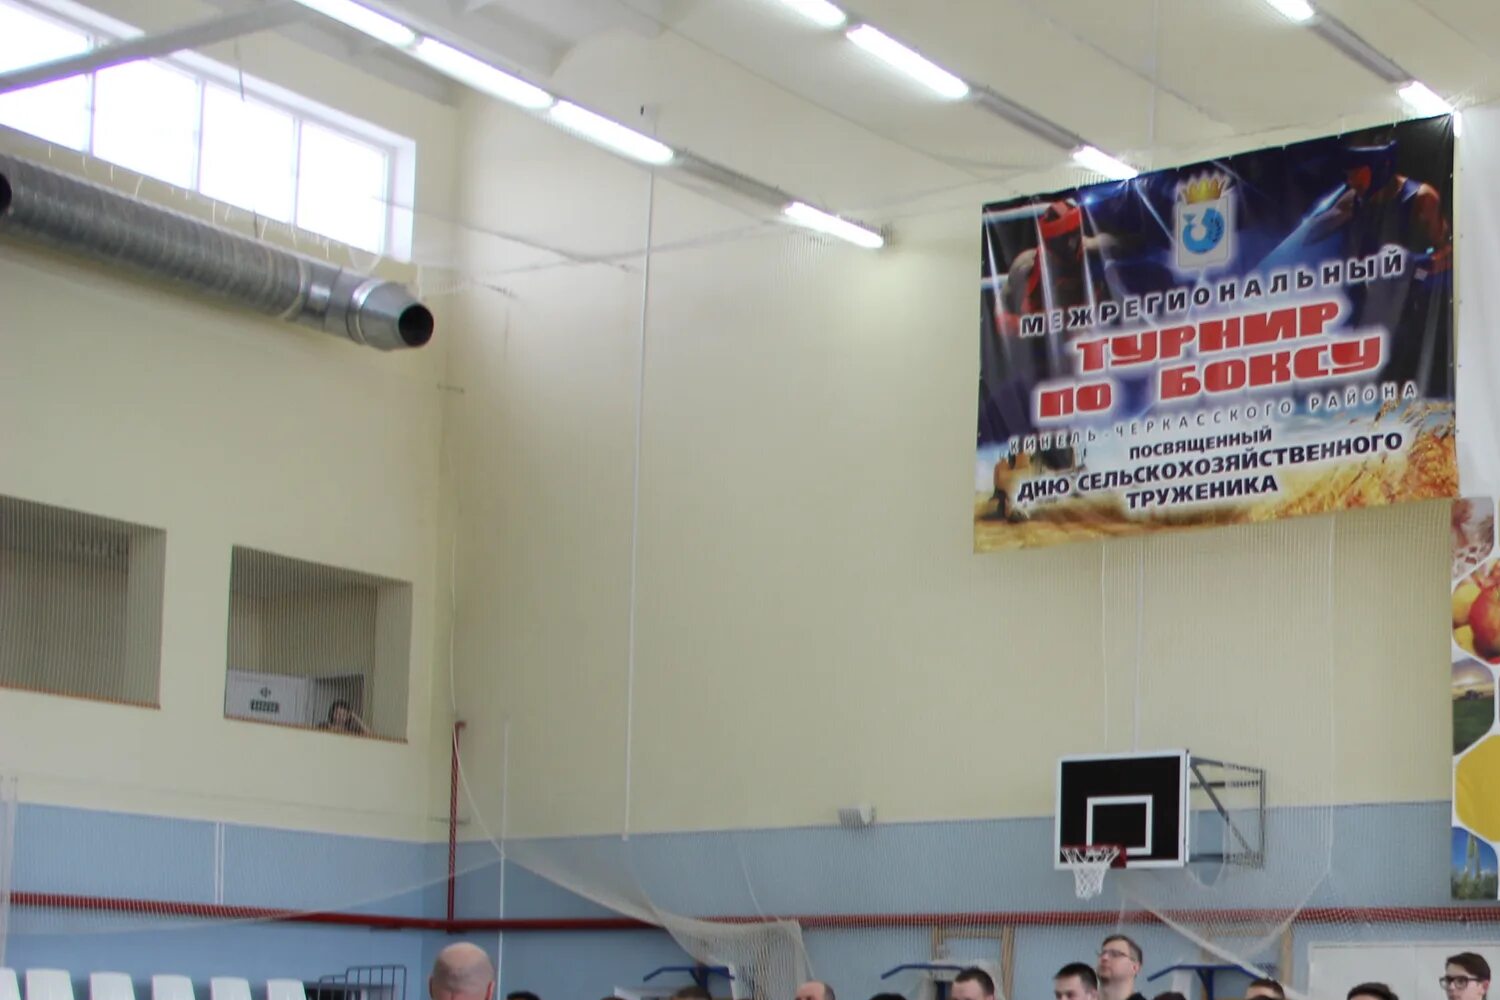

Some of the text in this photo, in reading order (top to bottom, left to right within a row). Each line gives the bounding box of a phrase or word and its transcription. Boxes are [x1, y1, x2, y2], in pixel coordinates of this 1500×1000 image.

[1019, 249, 1404, 337] МЕЖРЕГИОНАЛЬНЫЙ
[1076, 301, 1339, 372] ТУРНИР
[1038, 336, 1382, 418] ПО БОКСУ
[1310, 381, 1417, 412] РАЙОНА
[1017, 431, 1403, 503] ДНЮ СЕЛЬСКОХОЗЯЙСТВЕННОГО
[1129, 427, 1273, 460] ПОСВЯЩЕННЫЙ
[1125, 474, 1278, 511] ТРУЖЕНИКА
